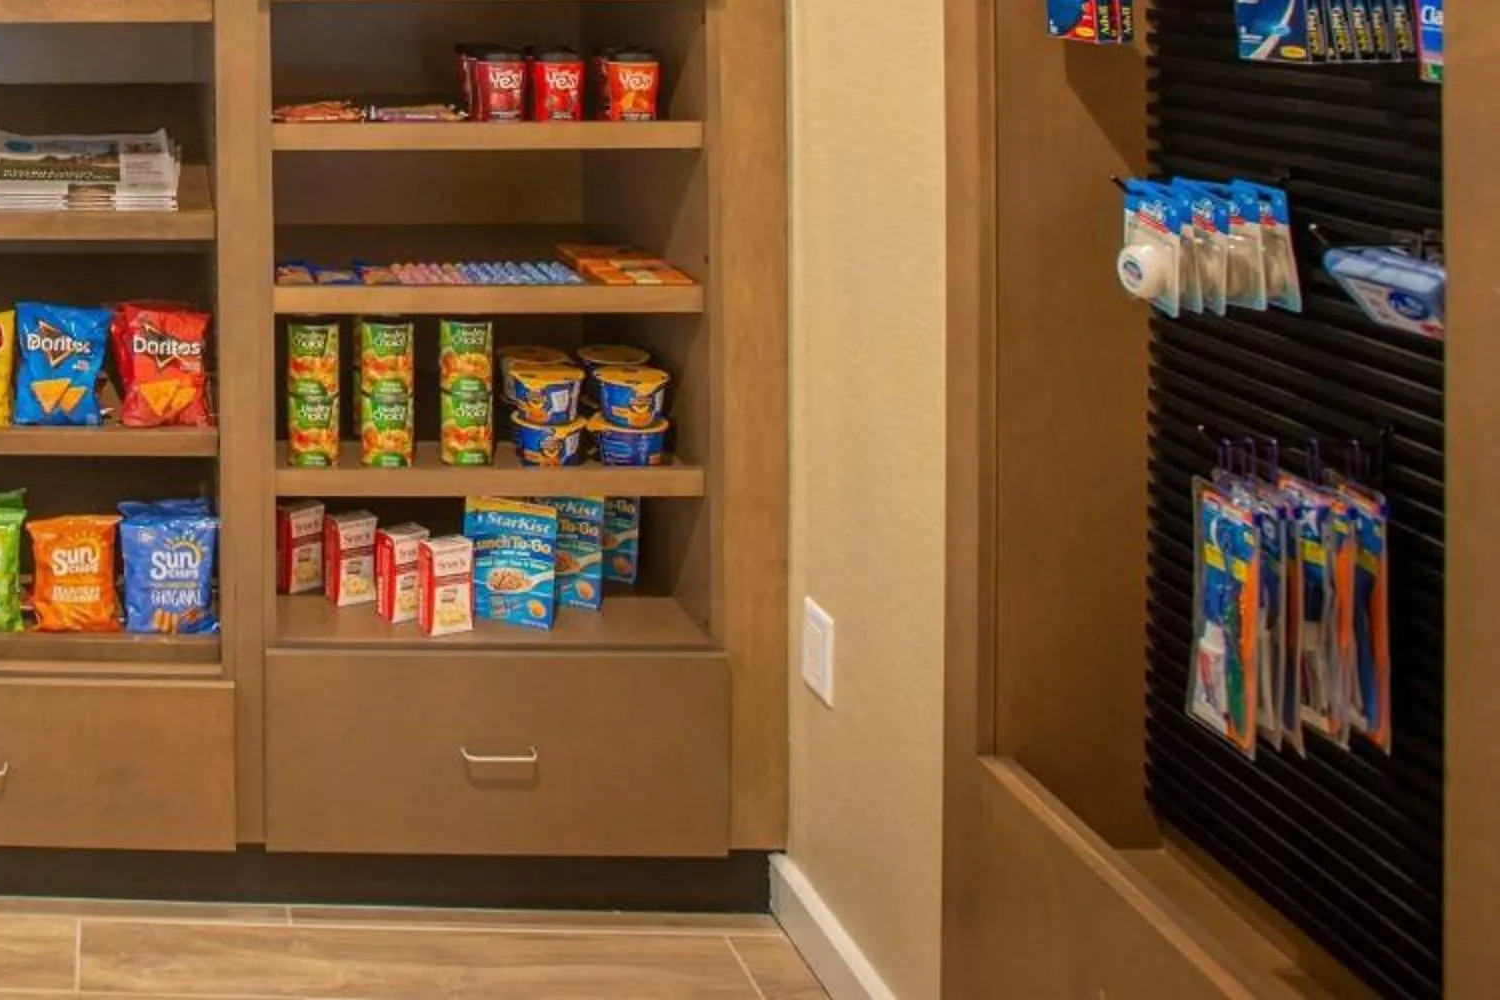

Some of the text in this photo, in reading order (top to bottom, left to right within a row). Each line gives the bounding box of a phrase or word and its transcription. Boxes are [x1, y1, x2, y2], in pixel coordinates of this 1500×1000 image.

[27, 333, 90, 353] Doritos
[133, 335, 201, 355] Doritos
[487, 512, 550, 534] StarKist
[52, 548, 100, 576] Sun
[151, 550, 200, 580] Sun
